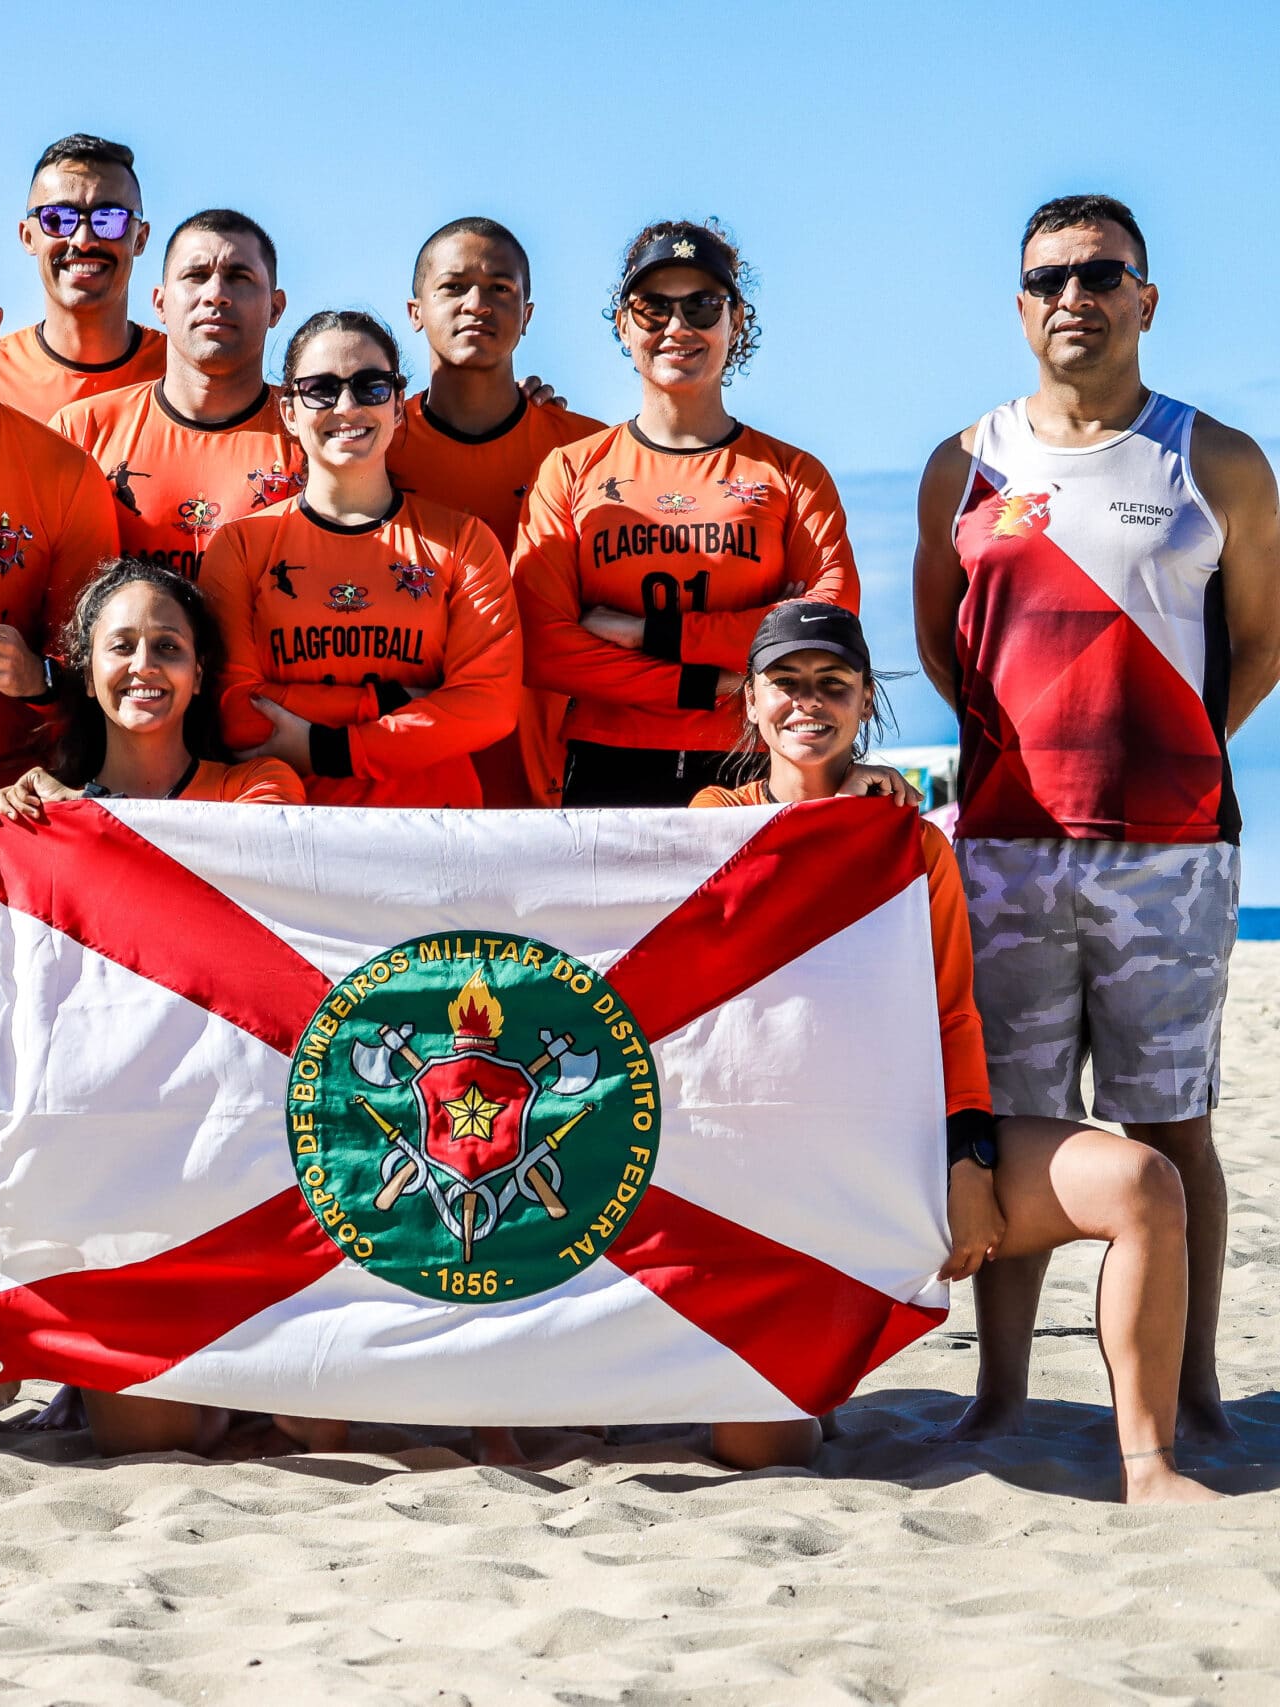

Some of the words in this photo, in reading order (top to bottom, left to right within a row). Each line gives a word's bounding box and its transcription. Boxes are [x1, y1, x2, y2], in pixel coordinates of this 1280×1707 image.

[1109, 502, 1173, 517] ATLETISMO
[1121, 514, 1161, 526] CBMDF
[593, 522, 761, 568] FLAGFOOTBALL
[270, 625, 424, 667] FLAGFOOTBALL
[419, 938, 544, 970] MILITAR
[552, 960, 592, 994] DO
[293, 952, 410, 1102] BOMBEIROS
[593, 994, 655, 1132] DISTRITO
[293, 1113, 317, 1154] DE
[305, 1165, 373, 1258] CORPO
[558, 1145, 651, 1266] FEDERAL
